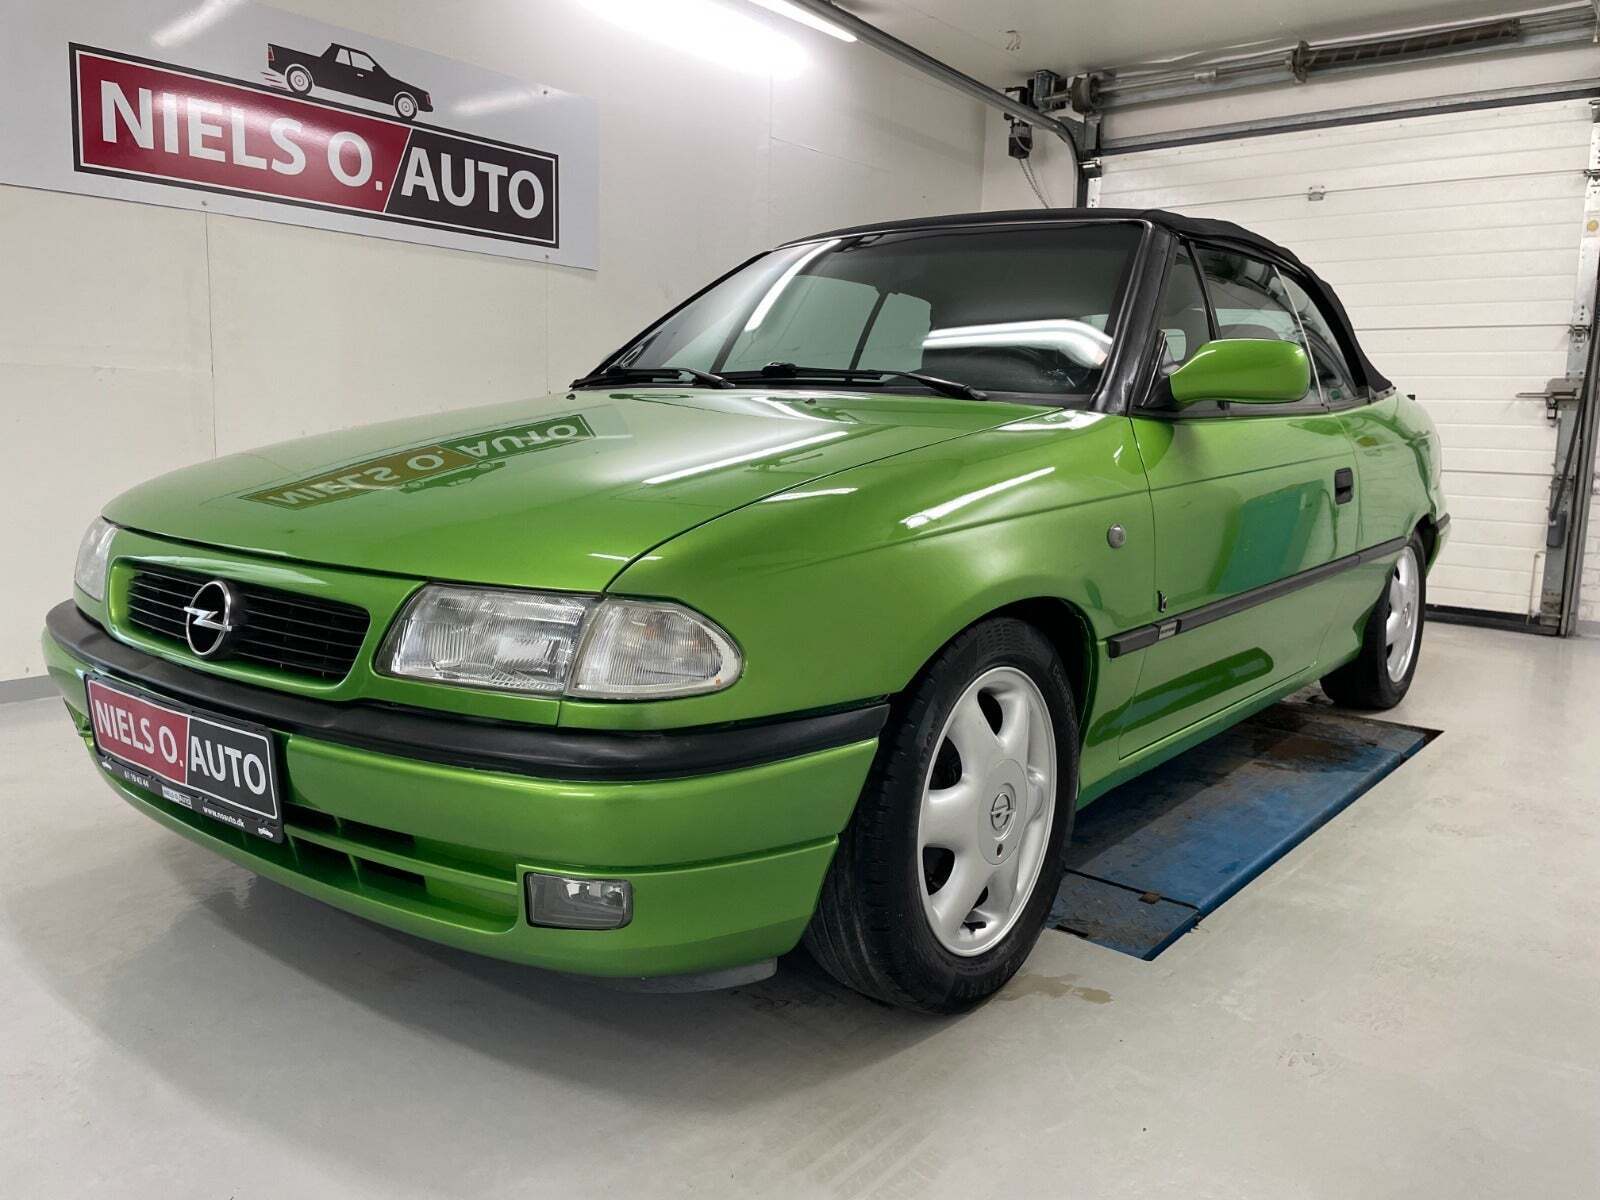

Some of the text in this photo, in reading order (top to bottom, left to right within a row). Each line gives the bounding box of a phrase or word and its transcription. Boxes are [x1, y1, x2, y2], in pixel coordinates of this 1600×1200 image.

[100, 80, 544, 219] NIELS O. AUTO
[95, 700, 267, 795] NIELS O. AUTO
